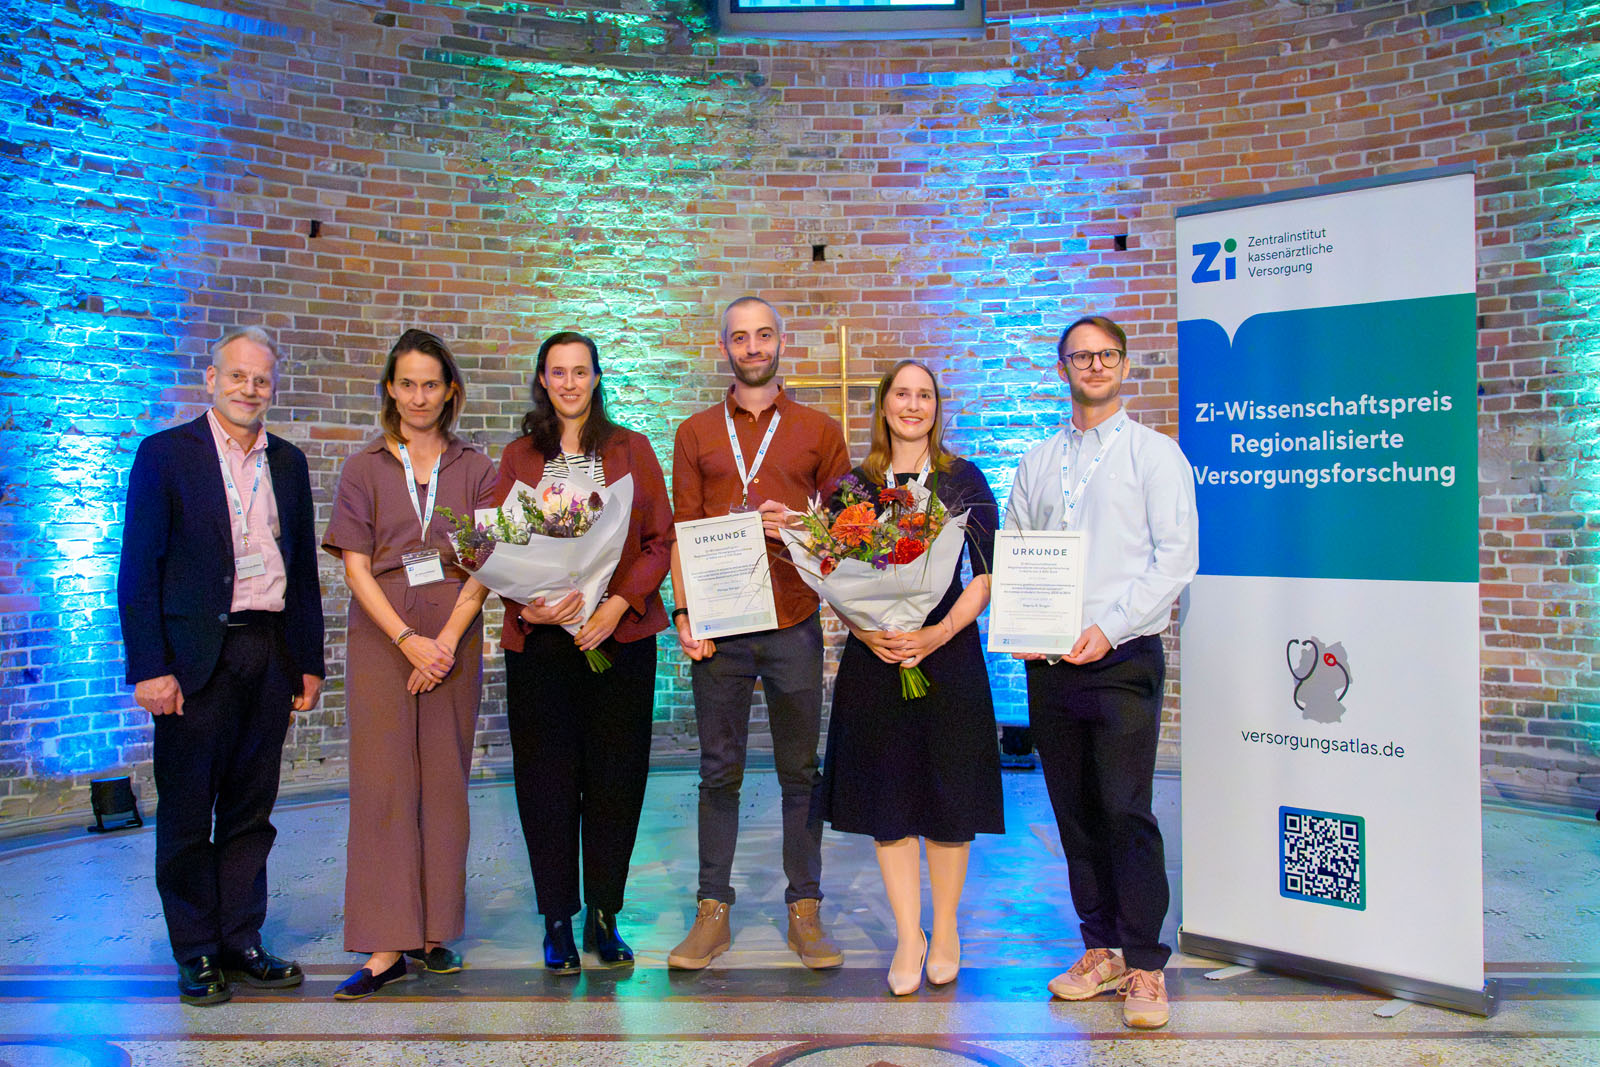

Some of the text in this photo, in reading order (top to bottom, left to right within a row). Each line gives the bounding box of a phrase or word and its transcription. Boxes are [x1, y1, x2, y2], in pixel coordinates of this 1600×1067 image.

[1247, 228, 1327, 248] Zentralinstitut
[1191, 238, 1238, 284] Zi
[1247, 242, 1334, 263] kassenärztliche
[1247, 261, 1313, 278] Versorgung
[1195, 391, 1453, 423] Zi-Wissenschaftspreis
[1230, 429, 1405, 458] Regionalisierte
[1193, 461, 1456, 489] Versorgungsforschung
[694, 530, 748, 545] URKUNDE
[1012, 548, 1069, 557] URKUNDE
[1241, 729, 1406, 759] versorgungsatlas.de
